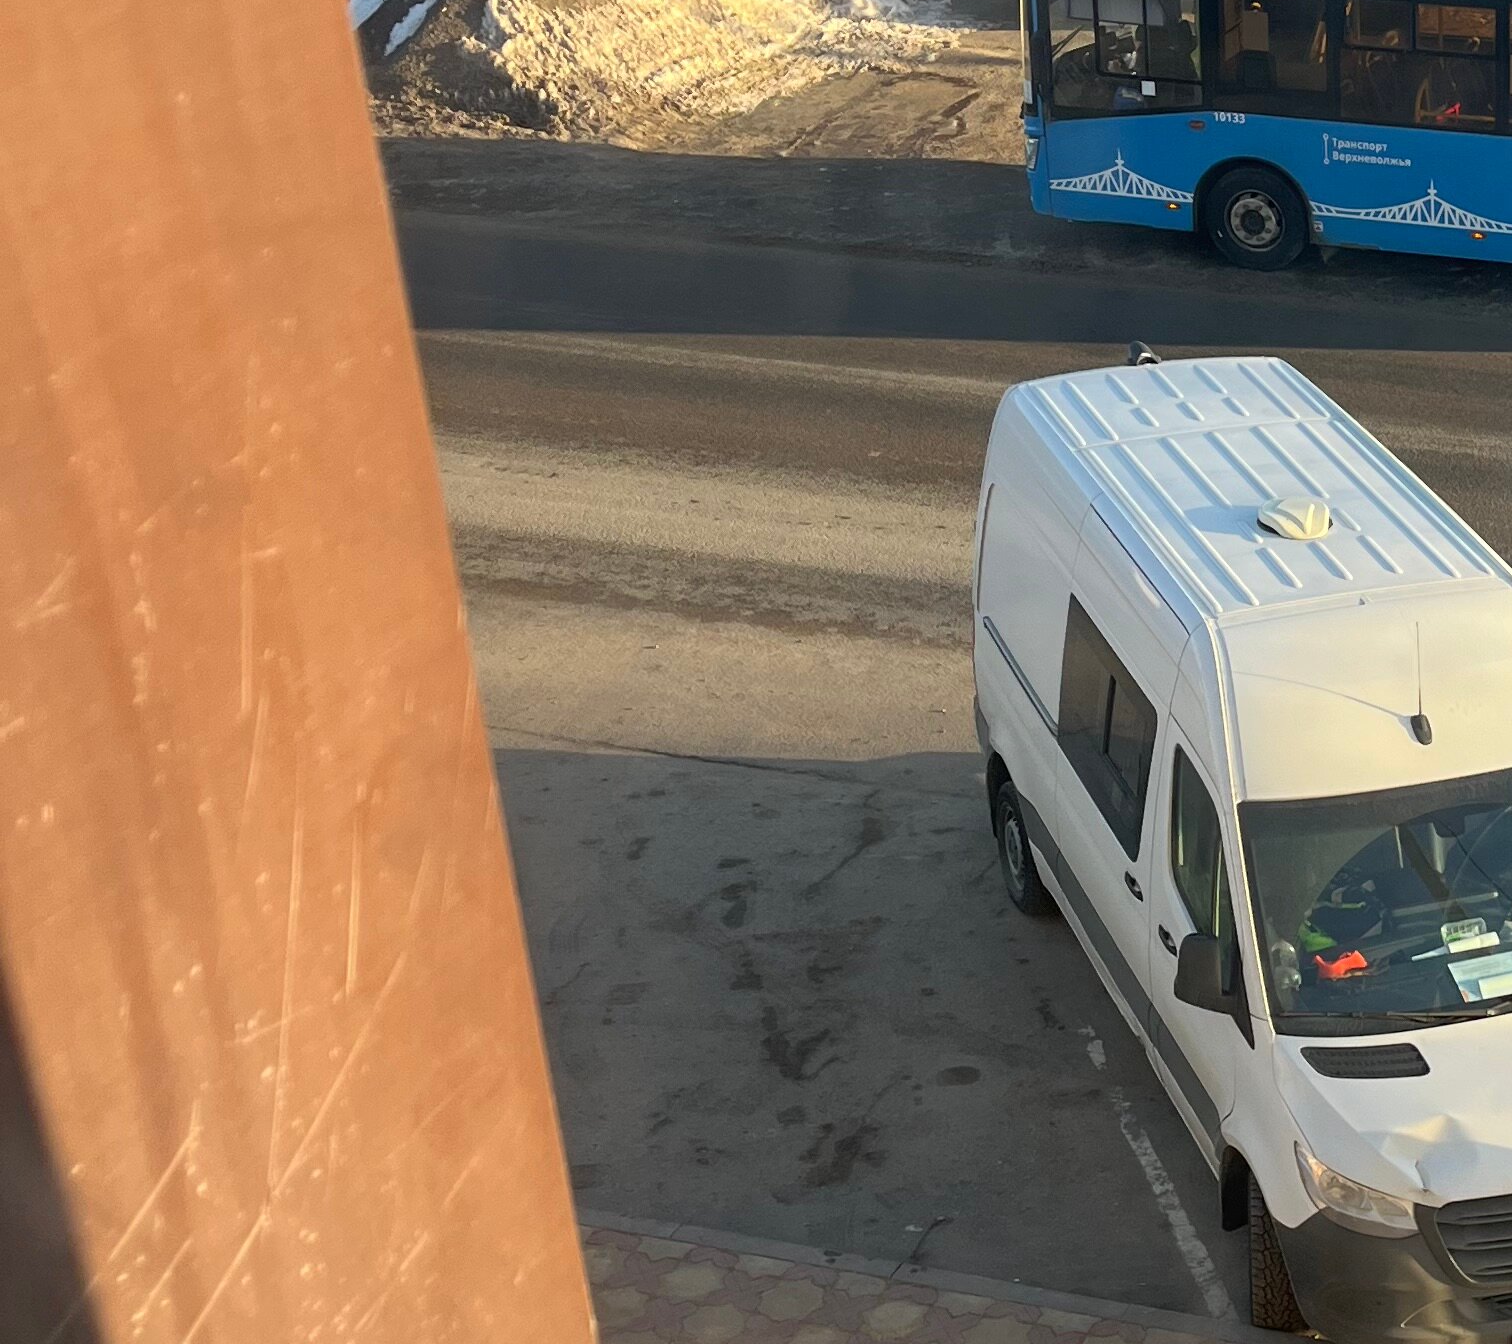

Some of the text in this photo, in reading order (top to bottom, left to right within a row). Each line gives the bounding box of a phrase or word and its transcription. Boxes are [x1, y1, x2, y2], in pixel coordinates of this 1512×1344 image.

[1213, 111, 1246, 124] 10133
[1332, 137, 1388, 154] Транспорт
[1332, 150, 1412, 167] Верхневолжья
